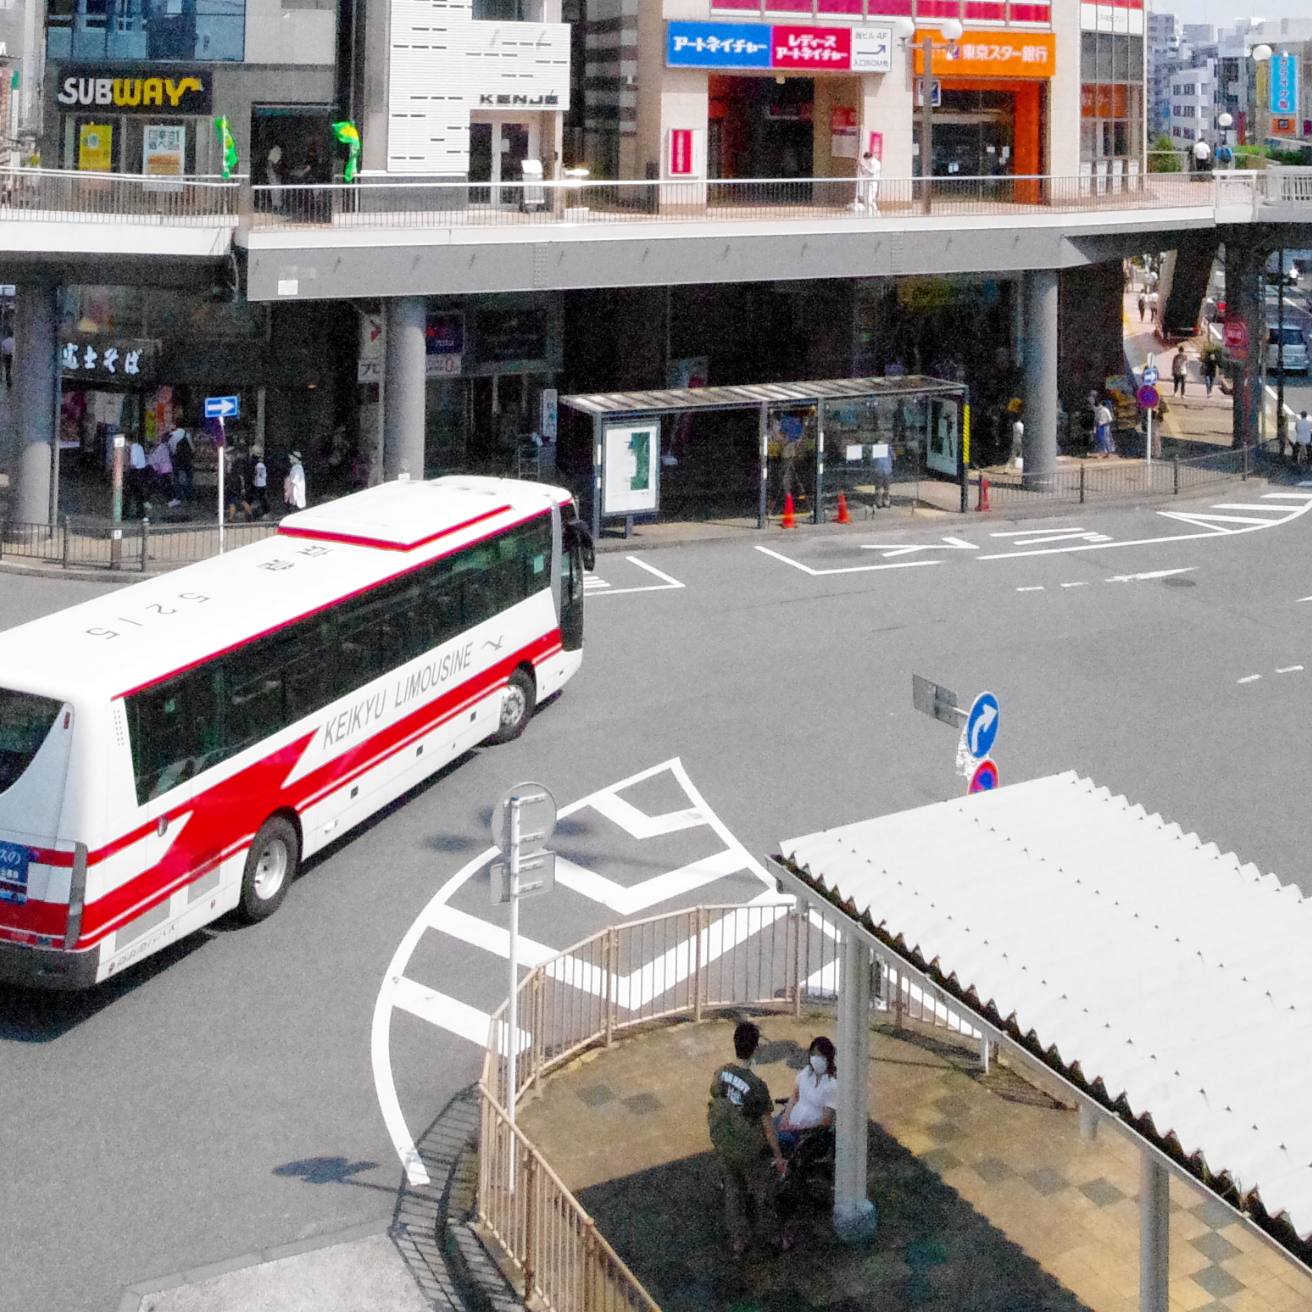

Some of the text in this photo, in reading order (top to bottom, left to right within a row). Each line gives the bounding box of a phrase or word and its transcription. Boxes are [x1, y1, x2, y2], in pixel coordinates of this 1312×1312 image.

[673, 35, 767, 53] アートネイチャー
[788, 34, 836, 48] レディース
[776, 46, 848, 61] アートネイチャー
[962, 43, 1048, 63] 東京スター銀行
[58, 77, 203, 106] SUBWAY
[323, 641, 473, 750] KEIKYU LIMOUSINE
